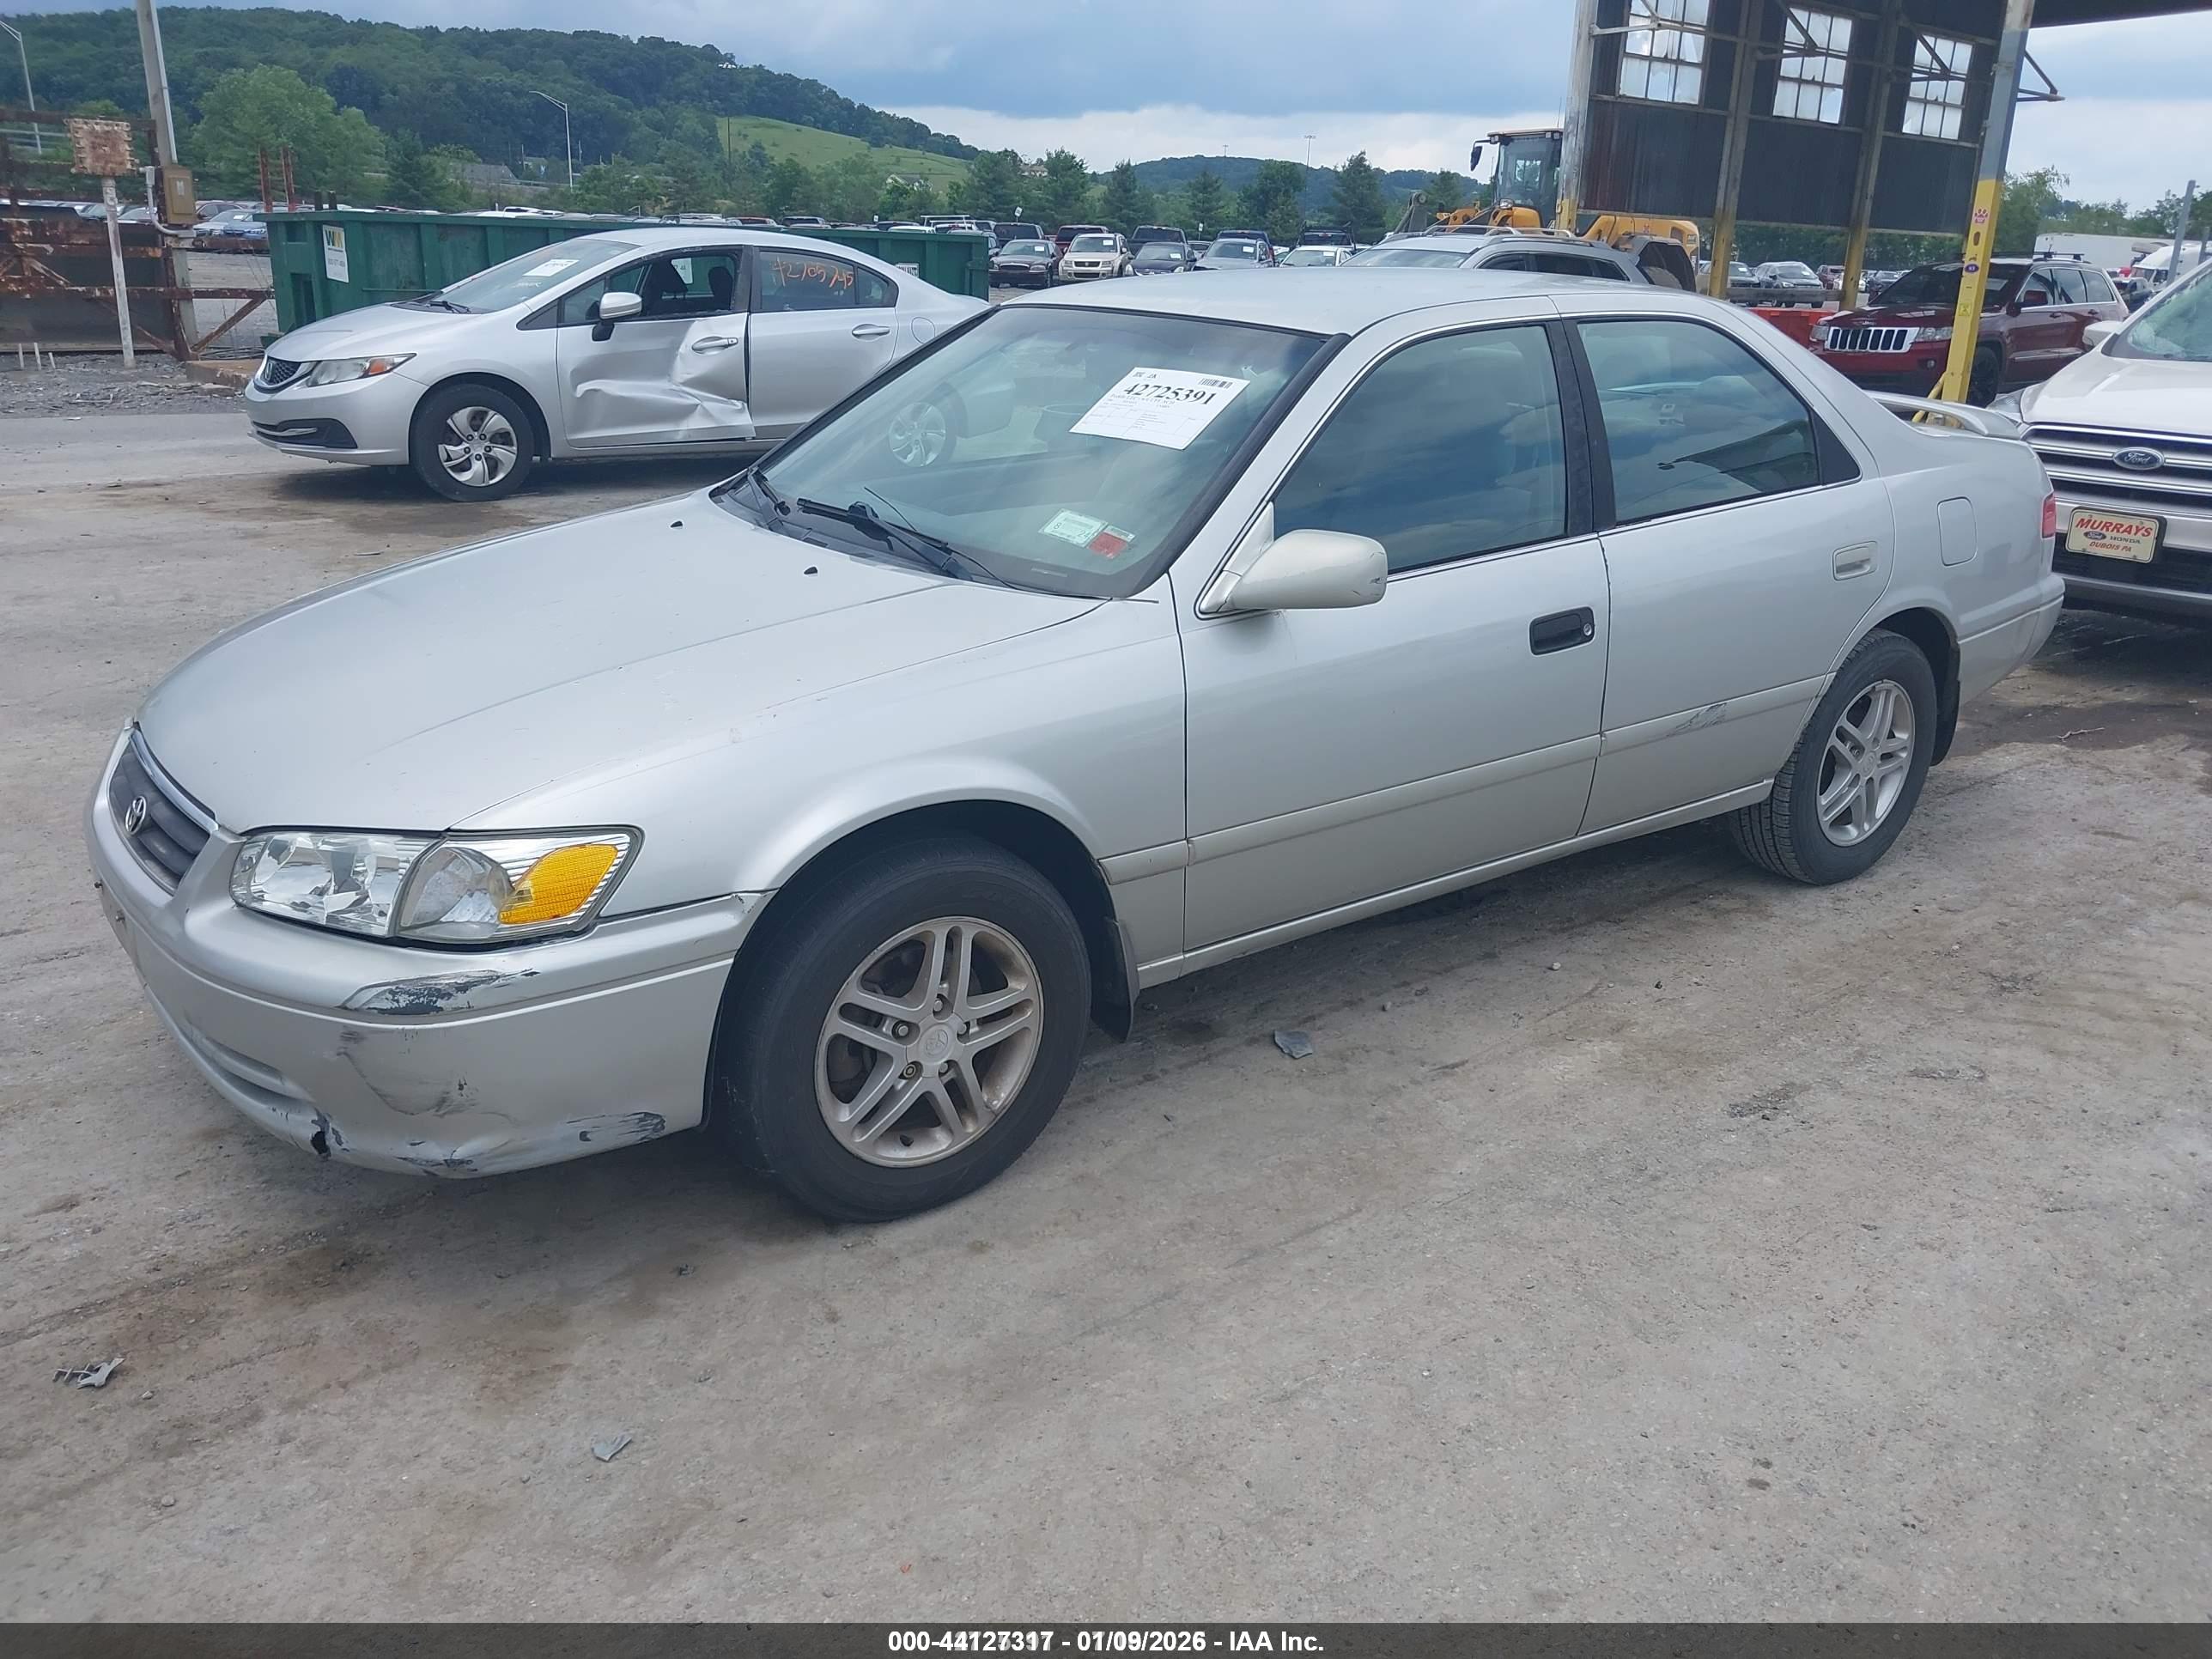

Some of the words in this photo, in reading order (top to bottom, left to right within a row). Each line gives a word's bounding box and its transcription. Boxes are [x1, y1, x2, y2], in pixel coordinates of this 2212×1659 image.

[1123, 383, 1217, 405] 42725391
[2123, 452, 2151, 465] Ford
[2110, 535, 2142, 544] HONDA
[2089, 541, 2119, 550] DUBOIS
